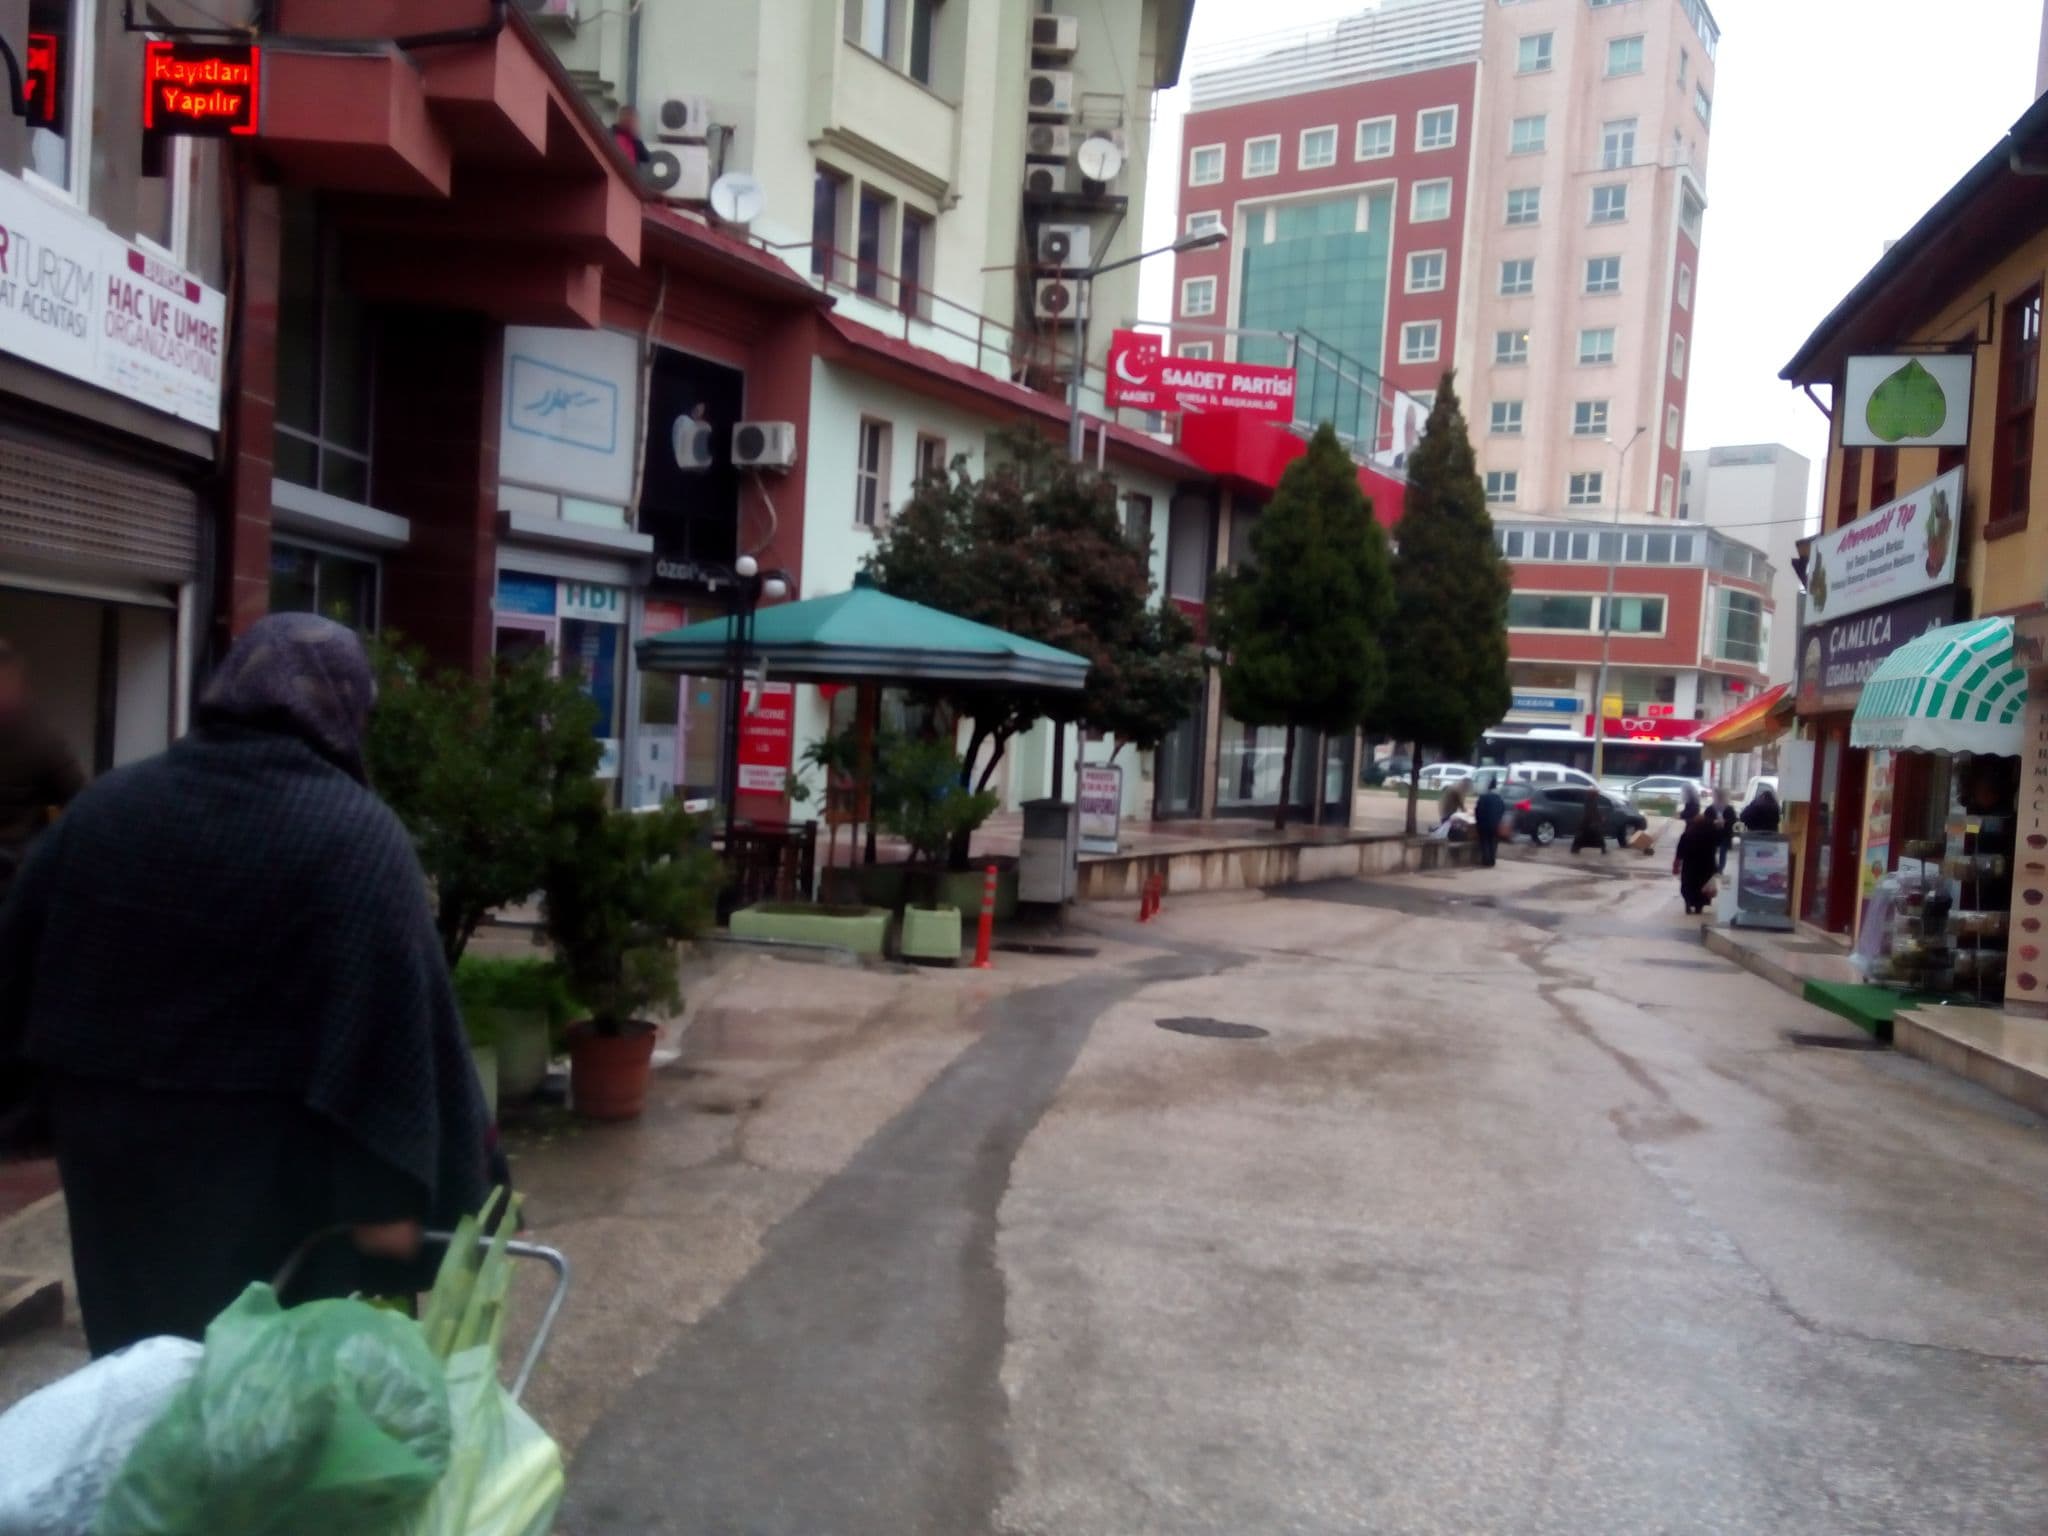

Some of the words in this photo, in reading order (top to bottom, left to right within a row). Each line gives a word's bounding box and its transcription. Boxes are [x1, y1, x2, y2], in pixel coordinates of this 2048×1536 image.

[154, 57, 250, 86] Kayıtları
[163, 88, 241, 117] Yapılır
[21, 290, 88, 338] ACENTASI
[107, 274, 144, 320] HAC
[149, 294, 170, 333] VE
[174, 307, 218, 356] UMRE
[1113, 390, 1156, 404] AADET
[1161, 367, 1227, 391] SAADET
[1231, 375, 1293, 397] PARTİSİ
[1829, 614, 1892, 661] ÇAMLICA
